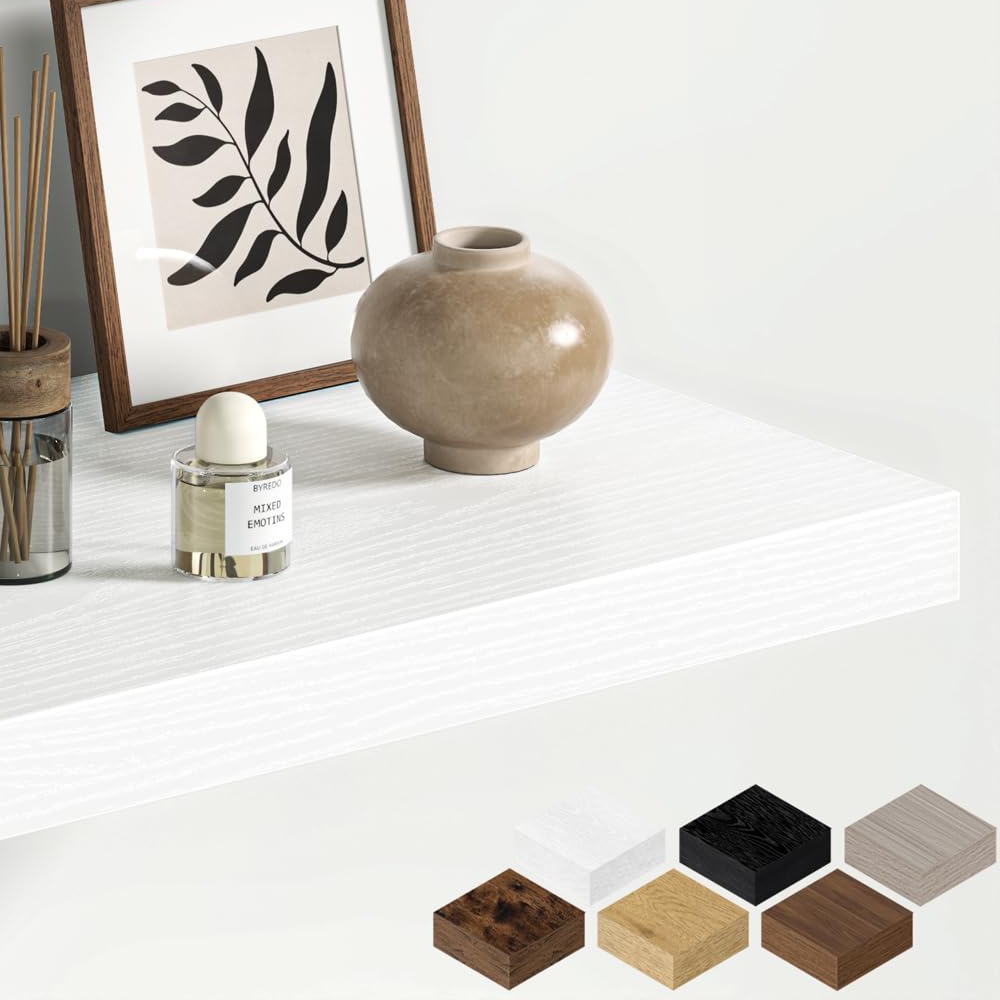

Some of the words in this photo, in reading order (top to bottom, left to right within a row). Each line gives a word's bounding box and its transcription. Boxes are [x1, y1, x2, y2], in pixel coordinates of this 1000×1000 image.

[253, 480, 281, 492] BYREDO
[253, 500, 281, 513] MIXED
[248, 512, 285, 529] EMOTINS
